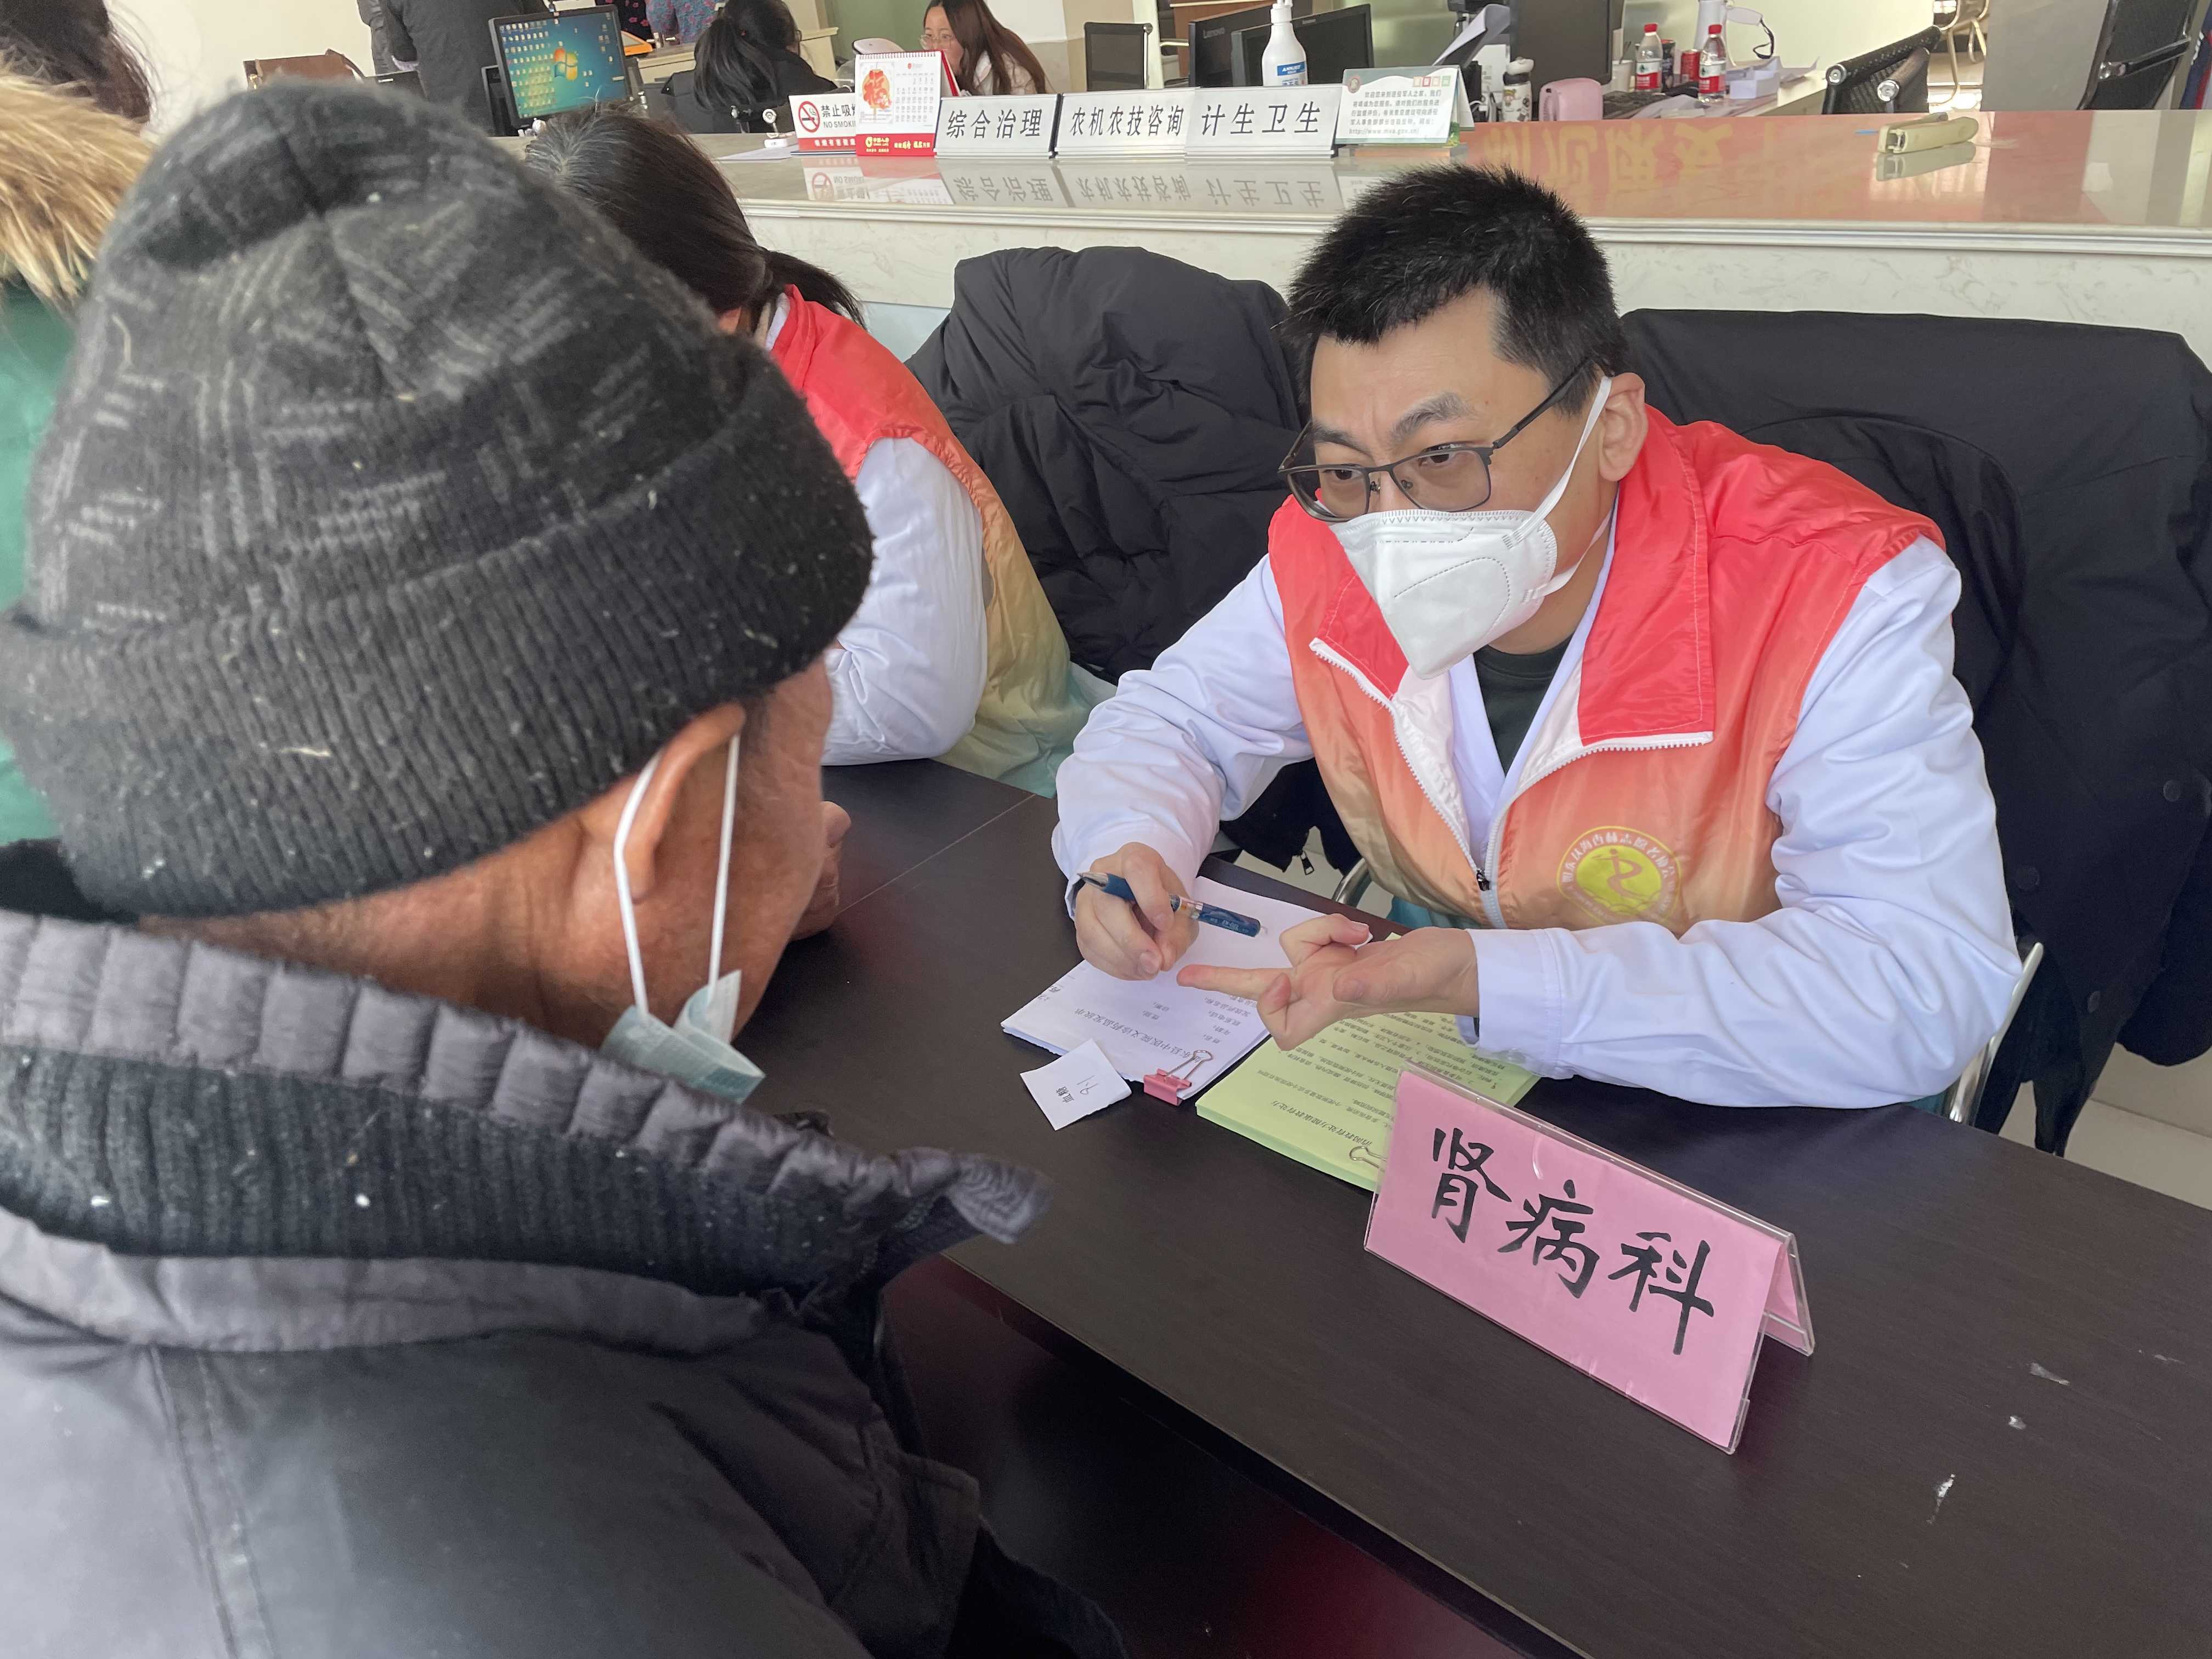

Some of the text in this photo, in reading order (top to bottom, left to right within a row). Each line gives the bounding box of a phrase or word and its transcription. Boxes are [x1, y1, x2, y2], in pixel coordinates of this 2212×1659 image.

[946, 109, 1043, 139] 综合治理
[1069, 104, 1184, 138] 农机农技咨询
[1201, 101, 1321, 137] 计生卫生
[1056, 1086, 1074, 1103] 血糖
[1431, 1126, 1715, 1356] 肾病科
